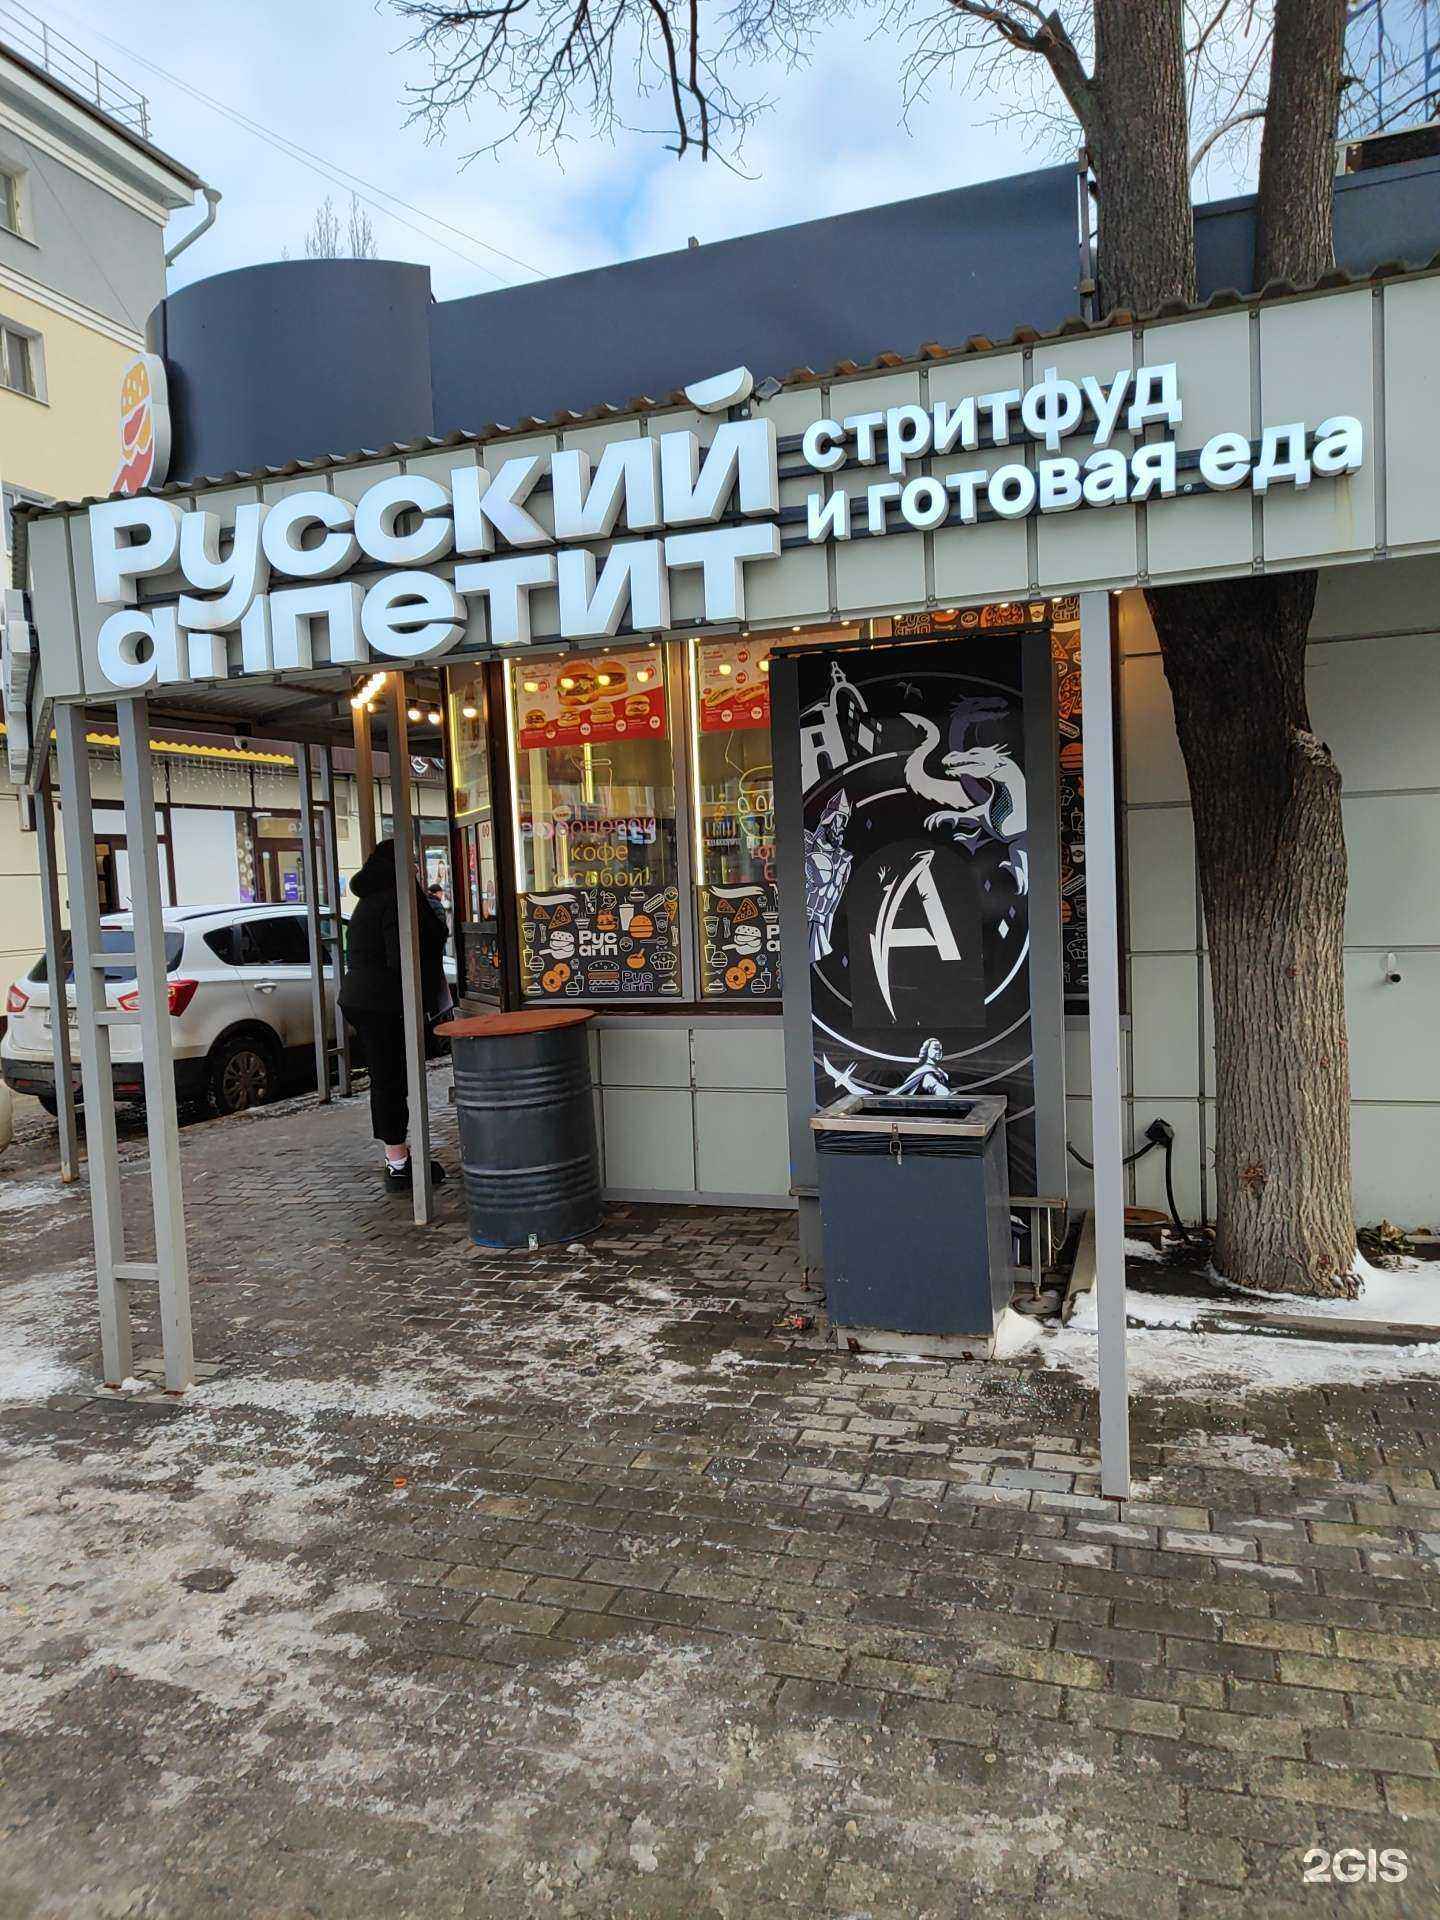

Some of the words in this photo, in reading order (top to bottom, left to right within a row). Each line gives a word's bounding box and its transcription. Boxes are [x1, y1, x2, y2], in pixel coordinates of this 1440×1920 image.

[802, 362, 1182, 478] стритфуд
[807, 487, 851, 544] и
[868, 441, 1176, 535] готовая
[1199, 415, 1363, 494] еда
[90, 366, 779, 629] Русский
[98, 523, 781, 689] аппетит
[571, 841, 629, 865] кофе
[579, 930, 618, 949] Рус
